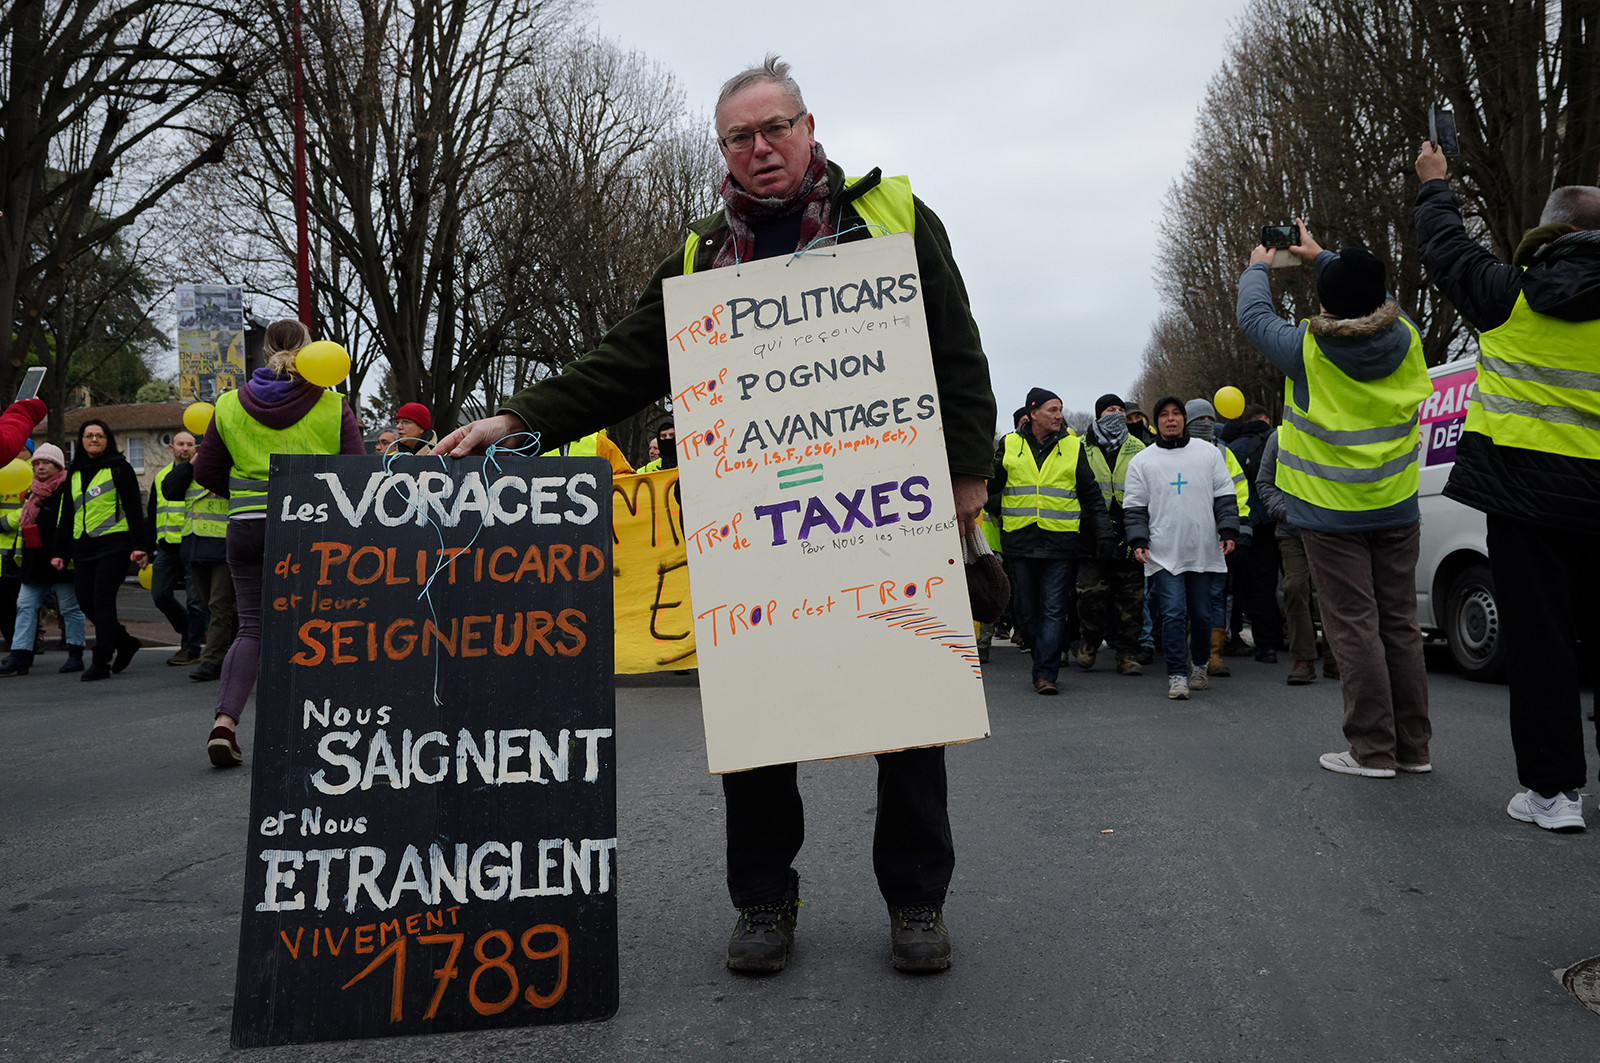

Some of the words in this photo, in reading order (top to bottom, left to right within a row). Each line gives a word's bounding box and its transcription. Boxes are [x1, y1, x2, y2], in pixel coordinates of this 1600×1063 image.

[670, 304, 724, 351] TROP
[709, 331, 727, 345] de
[726, 273, 917, 339] POLITICARS
[753, 337, 783, 359] qui
[793, 315, 904, 343] reçoivent
[673, 368, 727, 412] TROP
[709, 393, 723, 406] de
[737, 350, 885, 400] POGNON
[737, 394, 935, 454] AVANTAGES
[280, 495, 329, 523] Les
[314, 470, 599, 528] VORACES
[688, 513, 742, 554] TROP
[733, 536, 750, 550] de
[754, 475, 932, 546] TAXES
[274, 553, 301, 579] de
[310, 541, 605, 586] POLITICARD
[273, 593, 302, 611] et
[311, 590, 370, 613] leurs
[697, 600, 777, 647] TROP
[792, 596, 836, 620] c'est
[841, 576, 944, 611] TROP
[289, 608, 588, 666] SEIGNEURS
[303, 698, 392, 730] Nous
[310, 727, 612, 796] SAIGNENT
[259, 810, 296, 836] et
[300, 806, 368, 836] Nous
[255, 837, 618, 914] ETRANGLENT
[280, 905, 461, 960] VIVEMENT
[341, 923, 569, 1022] 1789
